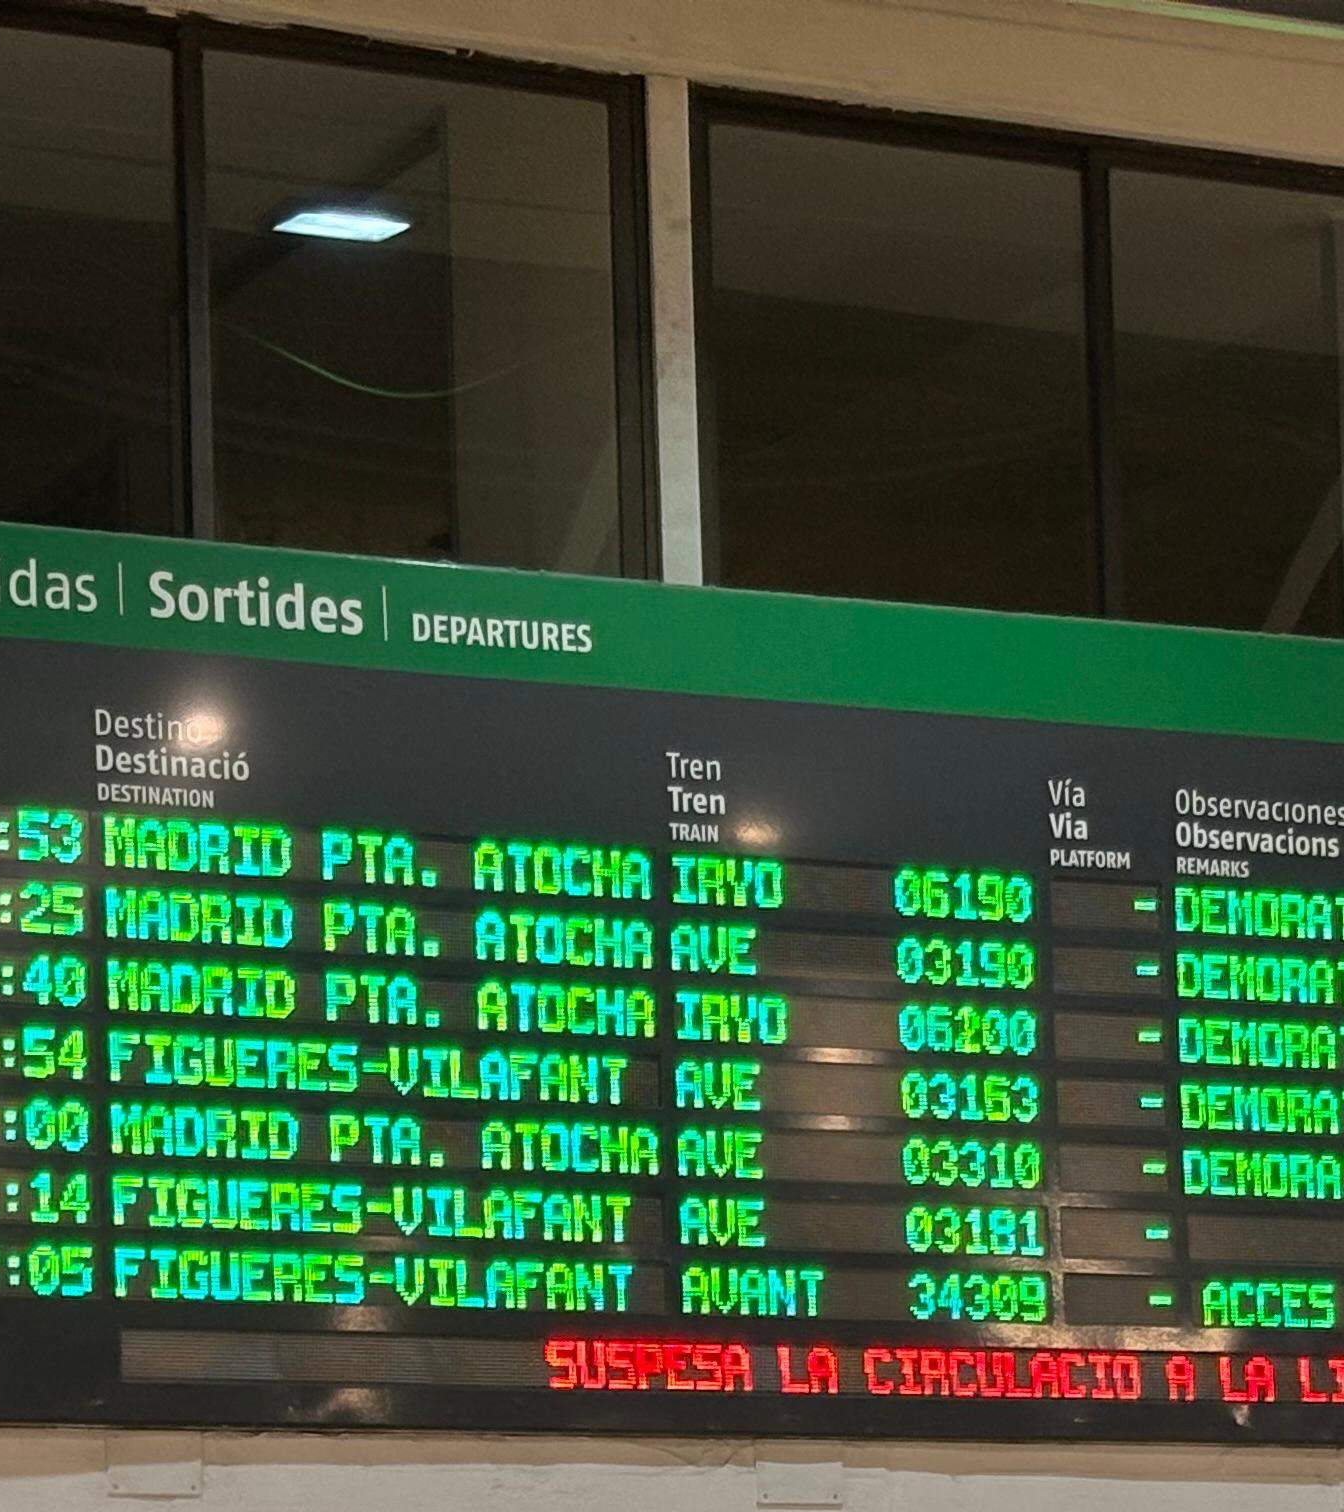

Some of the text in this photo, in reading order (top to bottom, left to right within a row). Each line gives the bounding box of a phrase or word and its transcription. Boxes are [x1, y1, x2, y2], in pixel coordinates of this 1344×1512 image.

[150, 571, 363, 635] Sortides
[413, 613, 592, 652] DEPARTURES
[94, 706, 208, 746] Destino
[94, 743, 252, 783] Destinació
[666, 752, 721, 780] Tren
[98, 783, 214, 808] DESTINATION
[667, 786, 725, 814] Tren
[1048, 778, 1085, 806] Vía
[669, 823, 718, 842] TRAIN
[1049, 812, 1087, 840] Via
[103, 812, 295, 876] MADRID
[321, 827, 438, 887] PTA.
[473, 840, 652, 900] ATOCHA
[672, 855, 784, 908] IRYO
[894, 866, 1032, 923] 06190
[1051, 849, 1130, 869] PLATFORM
[1177, 857, 1249, 877] REMARKS
[104, 885, 294, 948] MADRID
[323, 898, 440, 957] PTA.
[475, 910, 654, 969] ATOCHA
[671, 922, 759, 975] AVE
[897, 935, 1035, 989] 03190
[107, 958, 296, 1019] MADRID
[325, 969, 440, 1027] PTA.
[477, 980, 656, 1037] ATOCHA
[676, 990, 791, 1044] IRYO
[899, 1002, 1037, 1056] 06200
[108, 1031, 629, 1104] FIGUERES-VILAFANT
[675, 1059, 762, 1111] AVE
[900, 1069, 1040, 1123] 03163
[110, 1101, 300, 1160] MADRID
[329, 1112, 445, 1167] PTA.
[481, 1120, 659, 1175] ATOCHA
[677, 1128, 764, 1179] AVE
[902, 1135, 1042, 1189] 03310
[111, 1175, 631, 1242] FIGUERES-VILAFANT
[679, 1196, 766, 1247] AVE
[905, 1203, 1045, 1256] 03181
[114, 1248, 633, 1311] FIGUERES-VILAFANT
[682, 1264, 824, 1316] AVANT
[908, 1270, 1047, 1322] 34309
[1202, 1280, 1336, 1330] ACCES
[544, 1337, 753, 1391] SUSPESA
[777, 1345, 838, 1393] LA
[864, 1344, 1141, 1399] CIRCULACIO
[1165, 1356, 1196, 1400] A
[1219, 1357, 1275, 1402] LA
